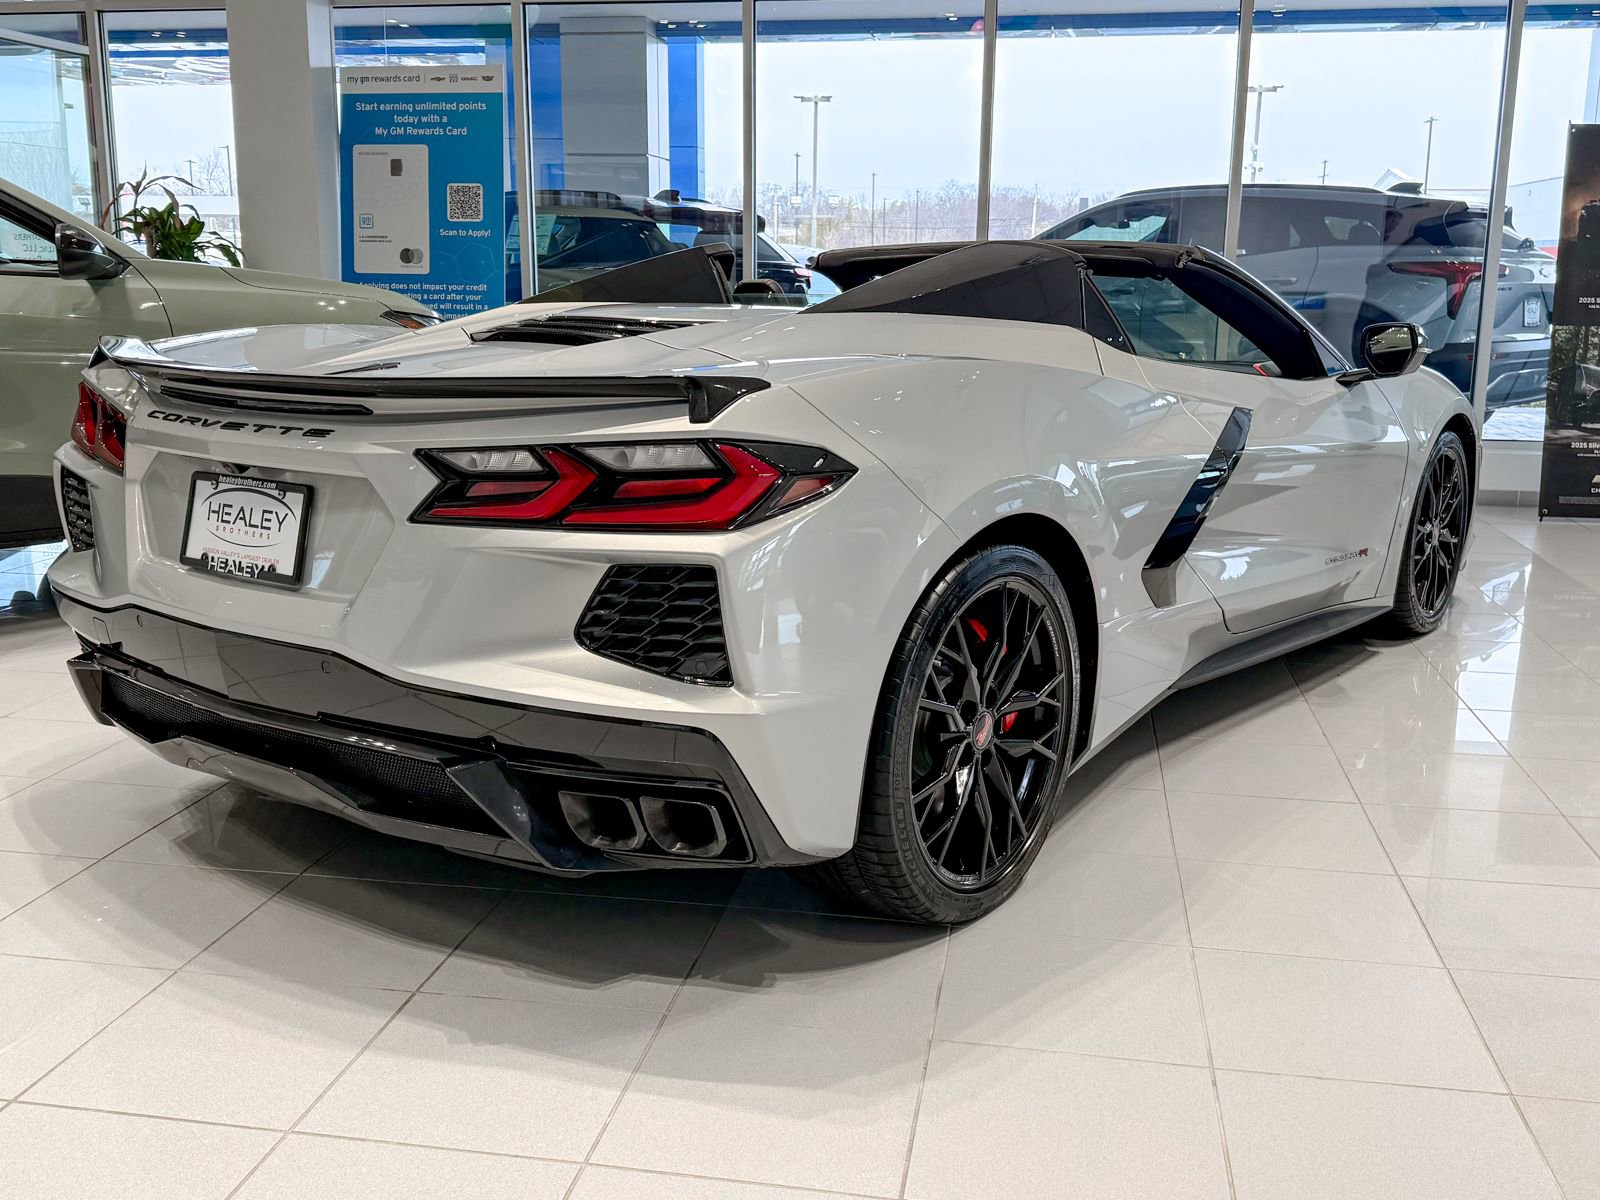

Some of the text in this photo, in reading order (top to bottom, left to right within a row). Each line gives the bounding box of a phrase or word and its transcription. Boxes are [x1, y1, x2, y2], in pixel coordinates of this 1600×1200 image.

[347, 74, 420, 84] my gm rewards card
[355, 101, 487, 112] Start earning unlimited points
[394, 114, 419, 125] today
[420, 114, 440, 122] with
[375, 126, 468, 138] My GM Rewards Card
[468, 228, 491, 238] Apply!
[422, 283, 446, 291] impact
[464, 283, 488, 292] credit
[147, 410, 336, 438] CORVETTE
[218, 475, 278, 490] healeybrothers.com
[207, 500, 288, 532] HEALEY
[216, 524, 271, 540] BROTHERS
[262, 556, 280, 565] DEALER
[208, 556, 262, 579] HEALEY
